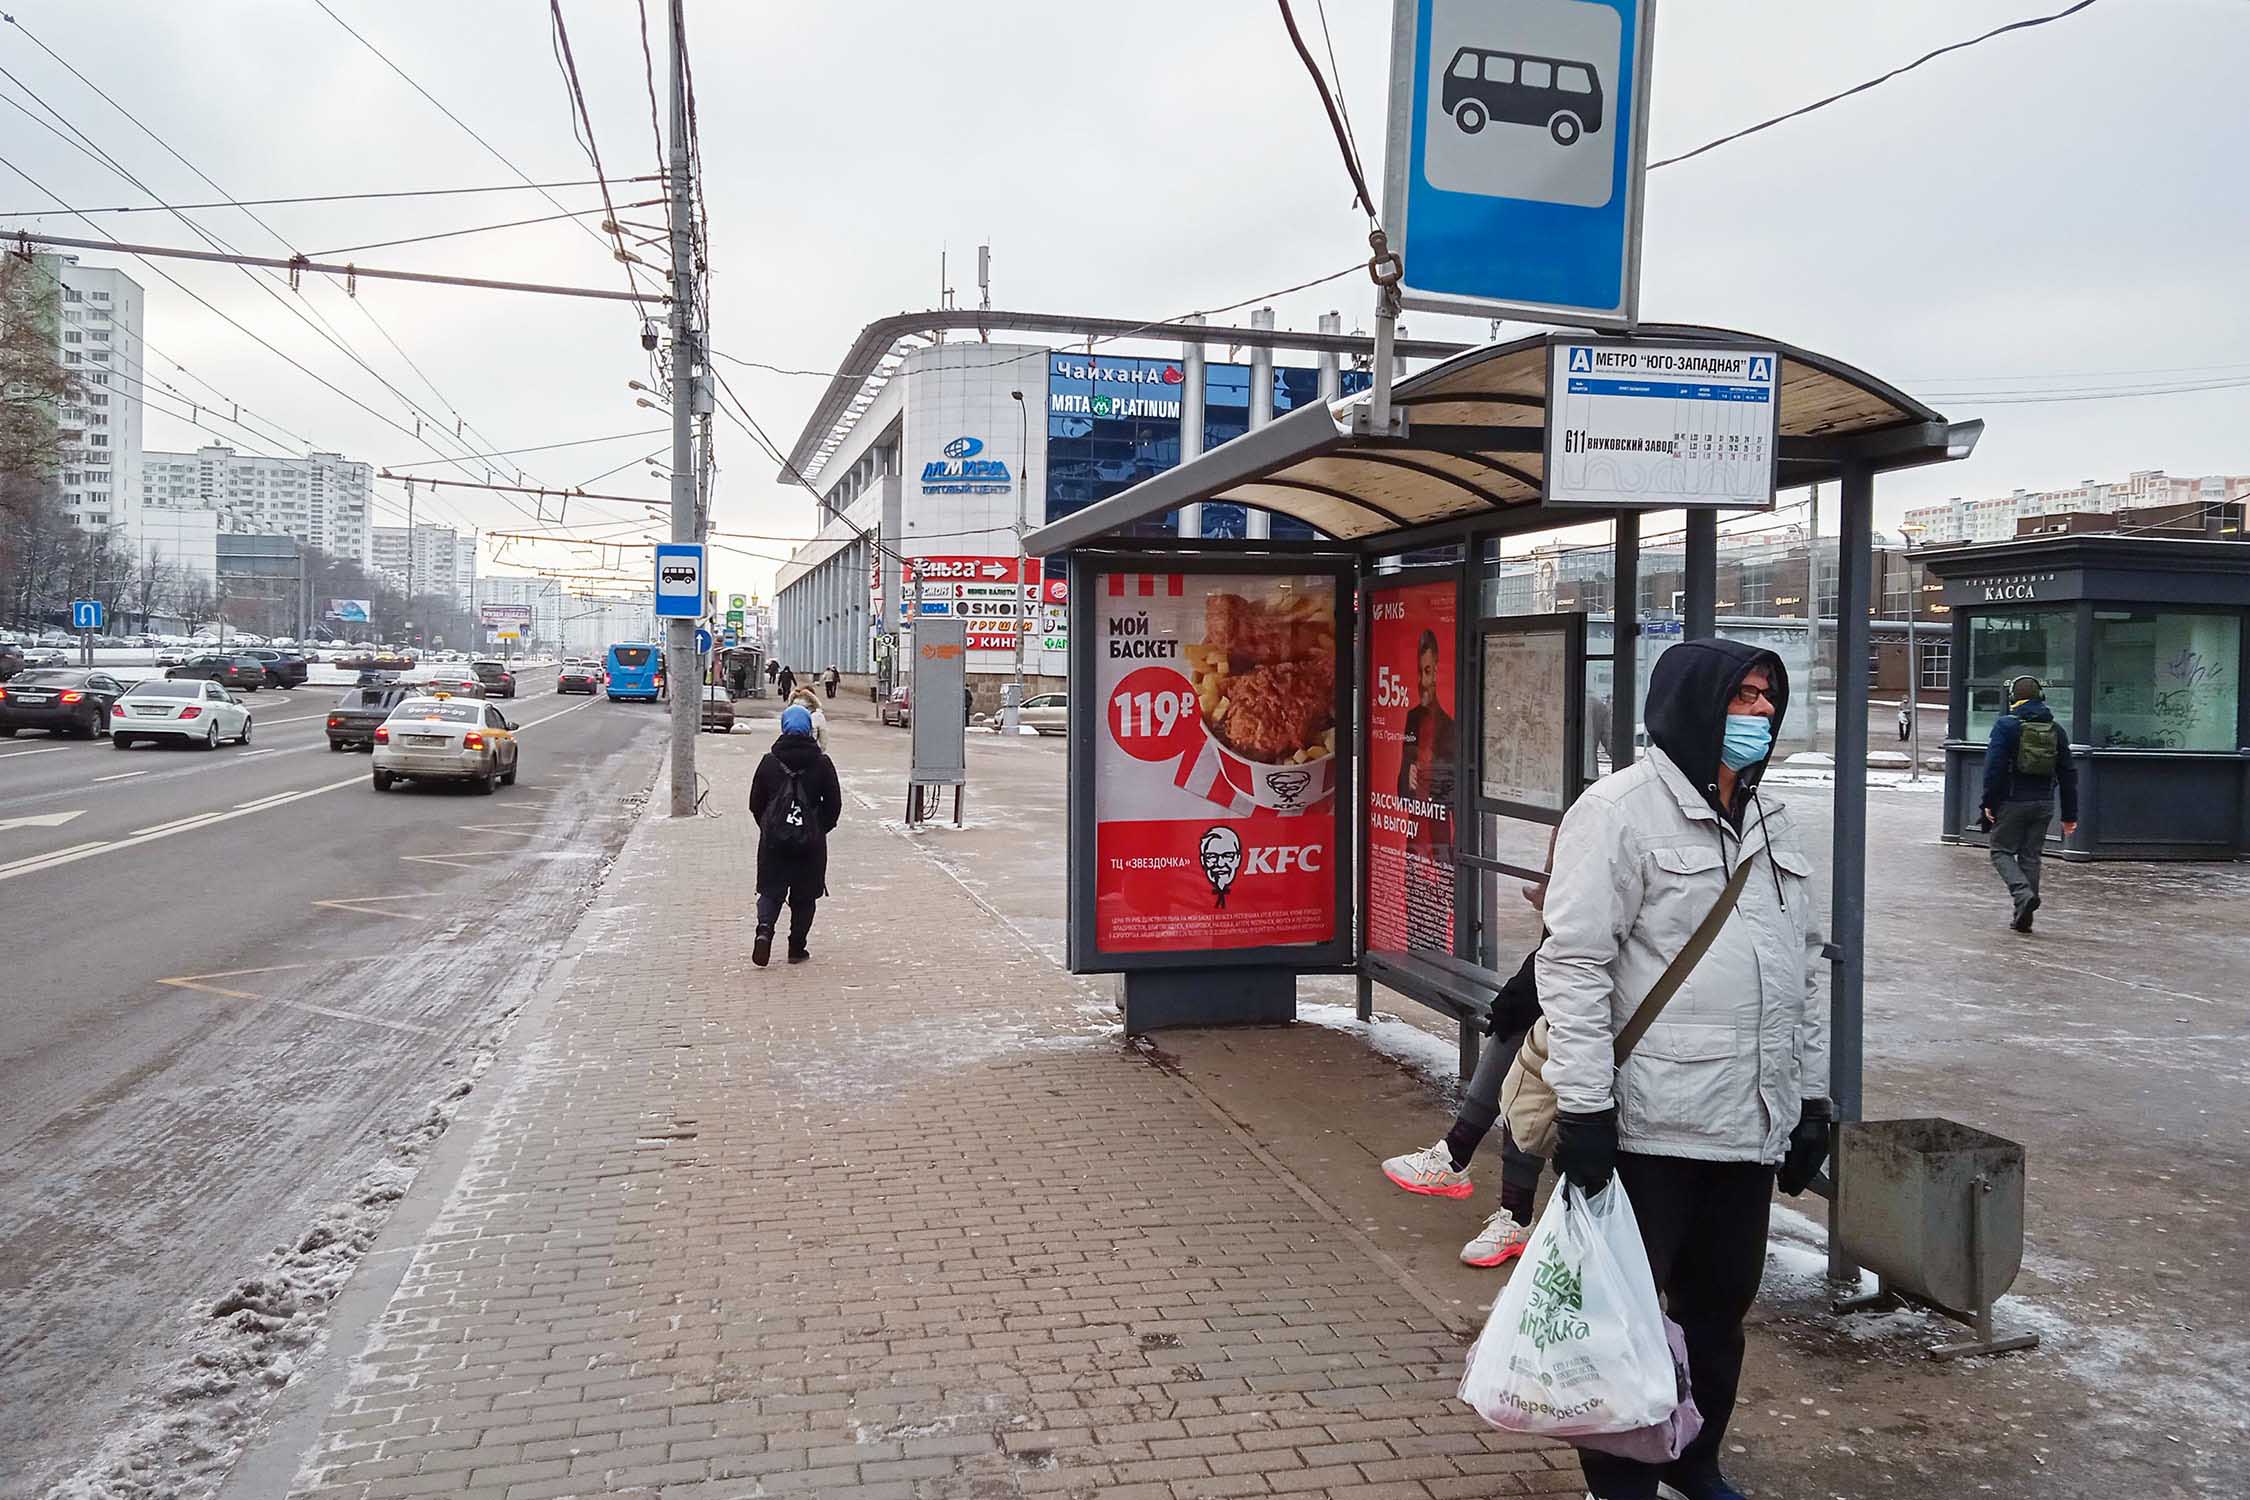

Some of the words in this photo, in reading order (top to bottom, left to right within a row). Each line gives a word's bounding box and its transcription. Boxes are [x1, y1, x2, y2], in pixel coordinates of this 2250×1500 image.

[1596, 352, 1637, 368] МЕТРО
[1052, 393, 1091, 413] МЯТА
[1112, 398, 1180, 419] PLATINUM
[1565, 429, 1586, 454] 611
[1587, 437, 1643, 452] ВНУКОВСКИЙ
[1645, 441, 1674, 455] ЗАВОД
[922, 483, 972, 495] ТОРГОВЫЙ
[975, 485, 1012, 495] ЦЕНТР
[1966, 573, 2055, 586] ТЕАТРАЛЬНАЯ
[1984, 585, 2035, 601] КАССА
[1384, 602, 1405, 620] МКБ
[1109, 611, 1149, 636] МОЙ
[1109, 639, 1178, 659] БАСКЕТ
[1370, 791, 1446, 822] РАССЧИТЫВАЙТЕ
[1370, 815, 1381, 829] НА
[1383, 817, 1419, 839] ВЫГОДУ
[1110, 858, 1124, 871] ТЦ
[1125, 857, 1191, 870] «ЗВЕЗДОЧКА»
[1244, 844, 1322, 876] KFC
